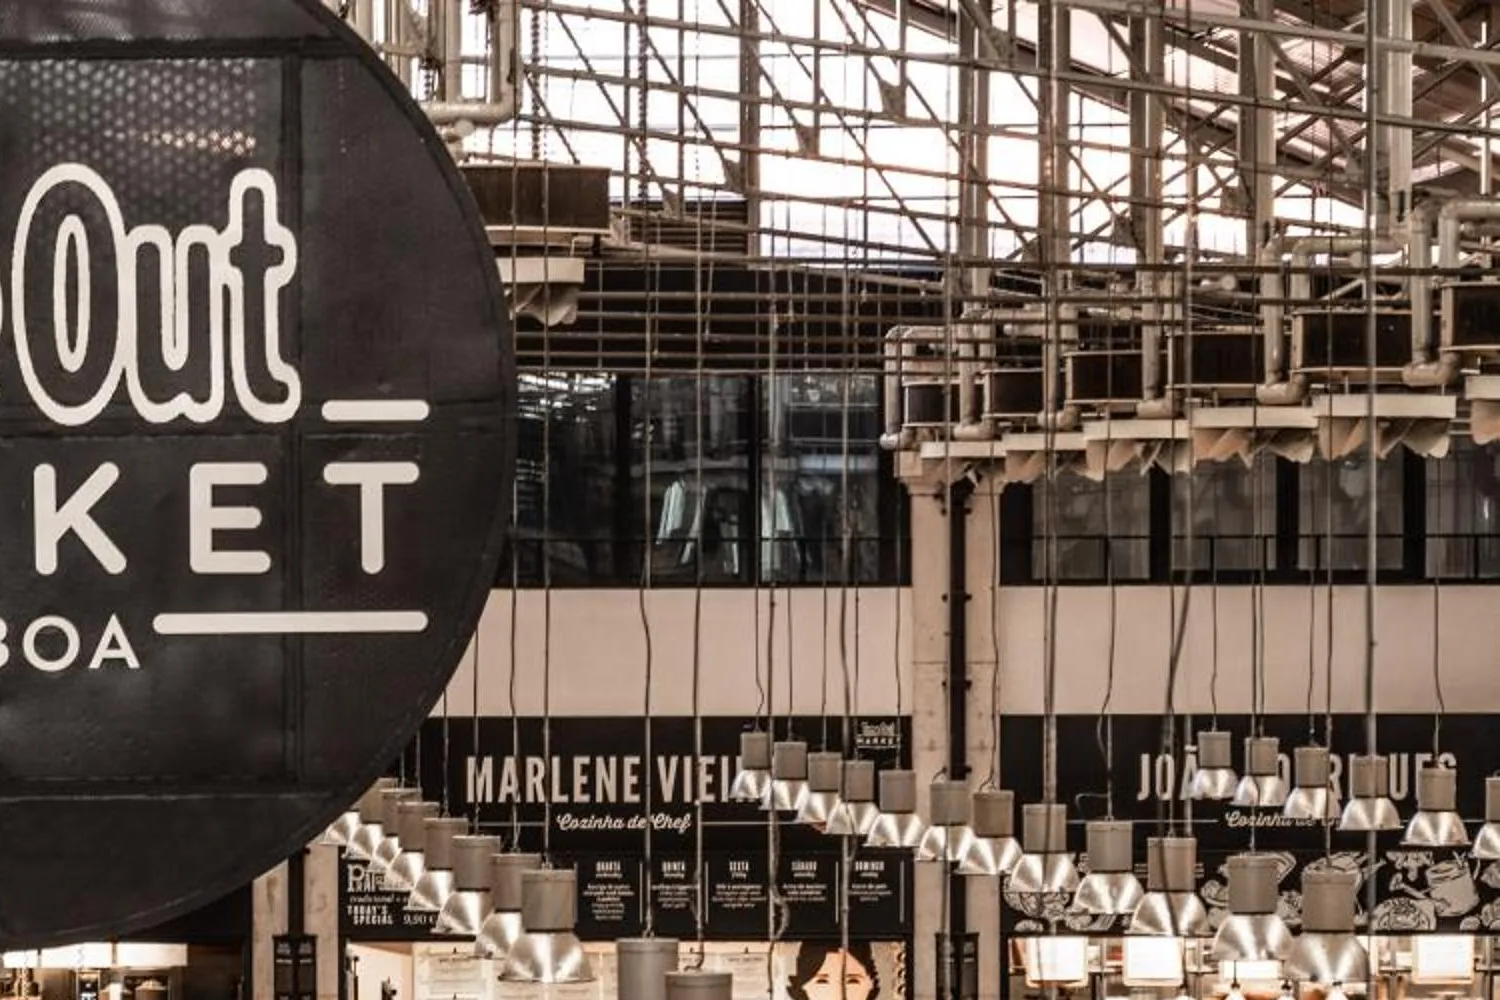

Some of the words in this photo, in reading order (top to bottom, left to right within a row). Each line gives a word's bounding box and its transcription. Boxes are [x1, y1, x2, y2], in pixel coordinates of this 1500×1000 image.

[11, 162, 303, 426] Out
[466, 755, 642, 804] MARLENE
[657, 755, 757, 804] VIEI
[1137, 746, 1213, 801] JOÃ
[556, 812, 625, 831] Cozinha
[627, 814, 647, 829] de
[649, 812, 692, 834] Chef
